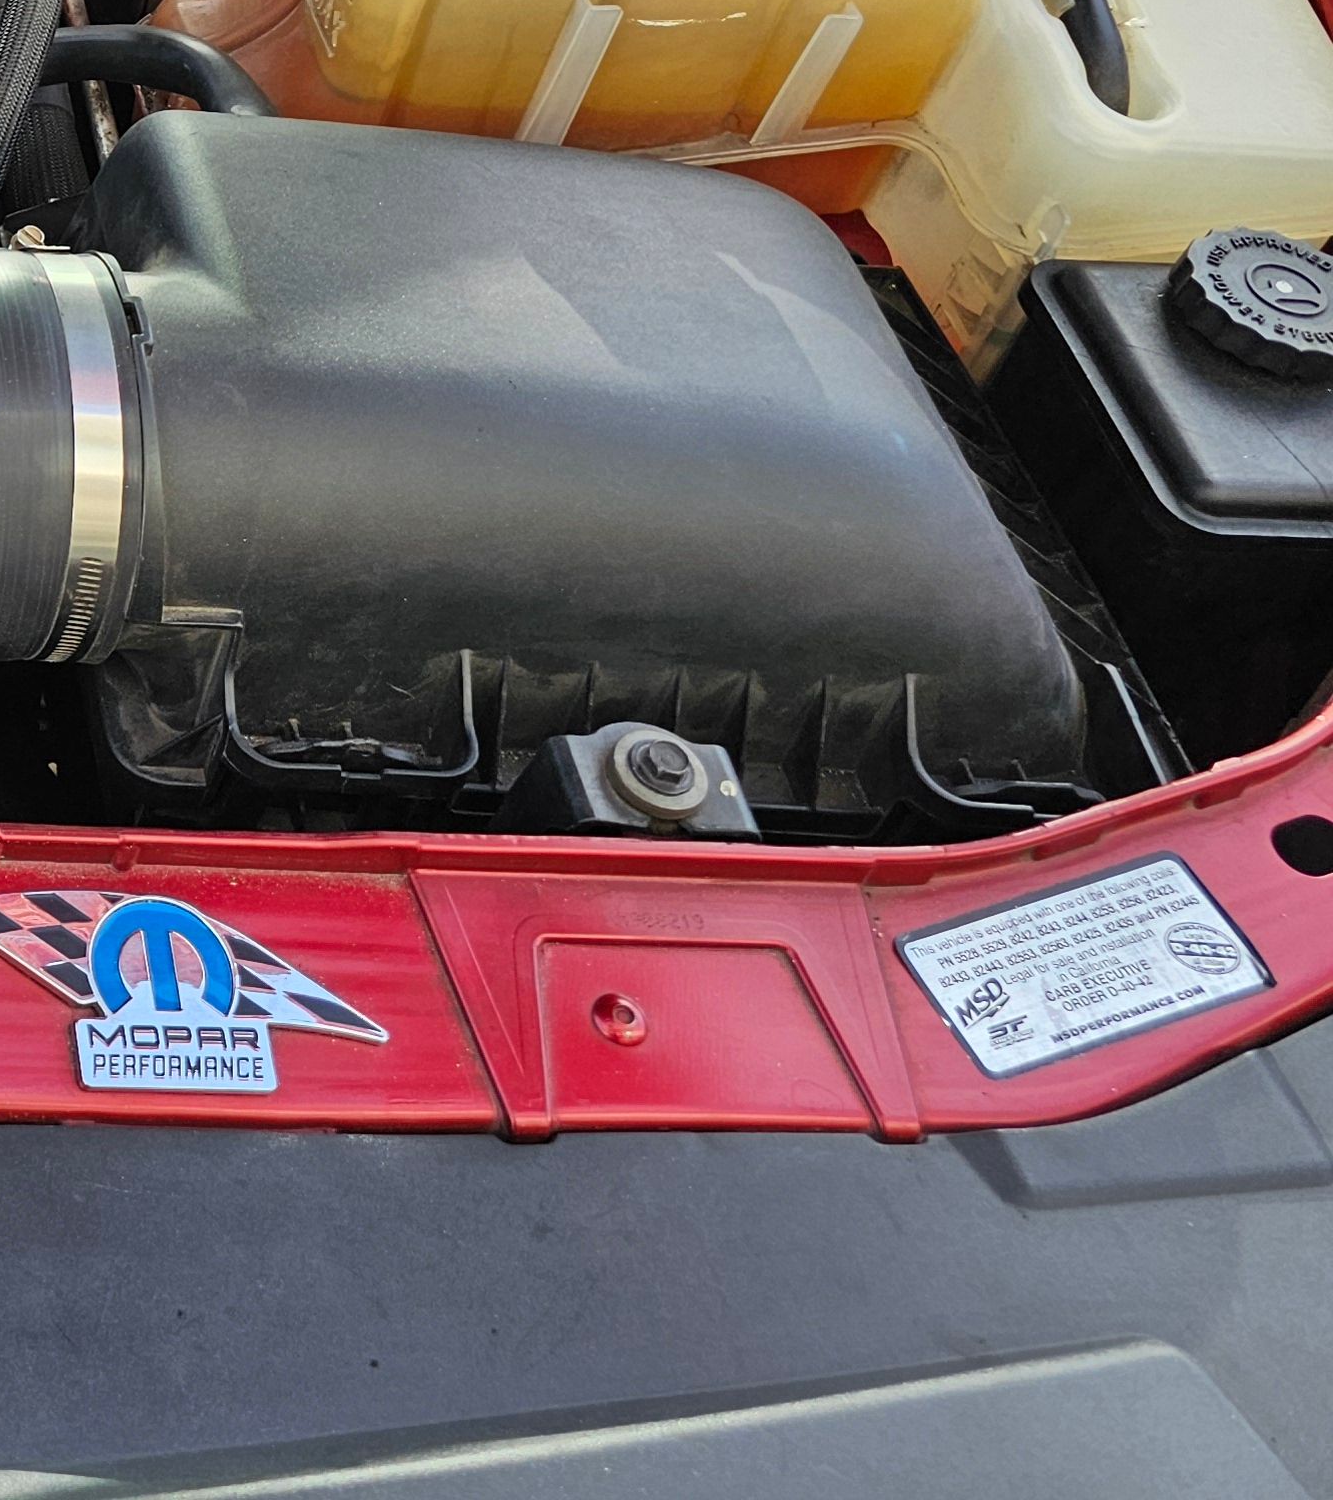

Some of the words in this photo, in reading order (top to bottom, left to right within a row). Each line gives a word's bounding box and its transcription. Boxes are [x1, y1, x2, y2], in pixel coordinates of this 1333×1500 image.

[1206, 243, 1231, 268] USE
[1208, 272, 1267, 326] POWER
[953, 976, 1006, 1027] MSD
[86, 1023, 261, 1052] MOPAR
[92, 1053, 264, 1082] PERFORMANCE
